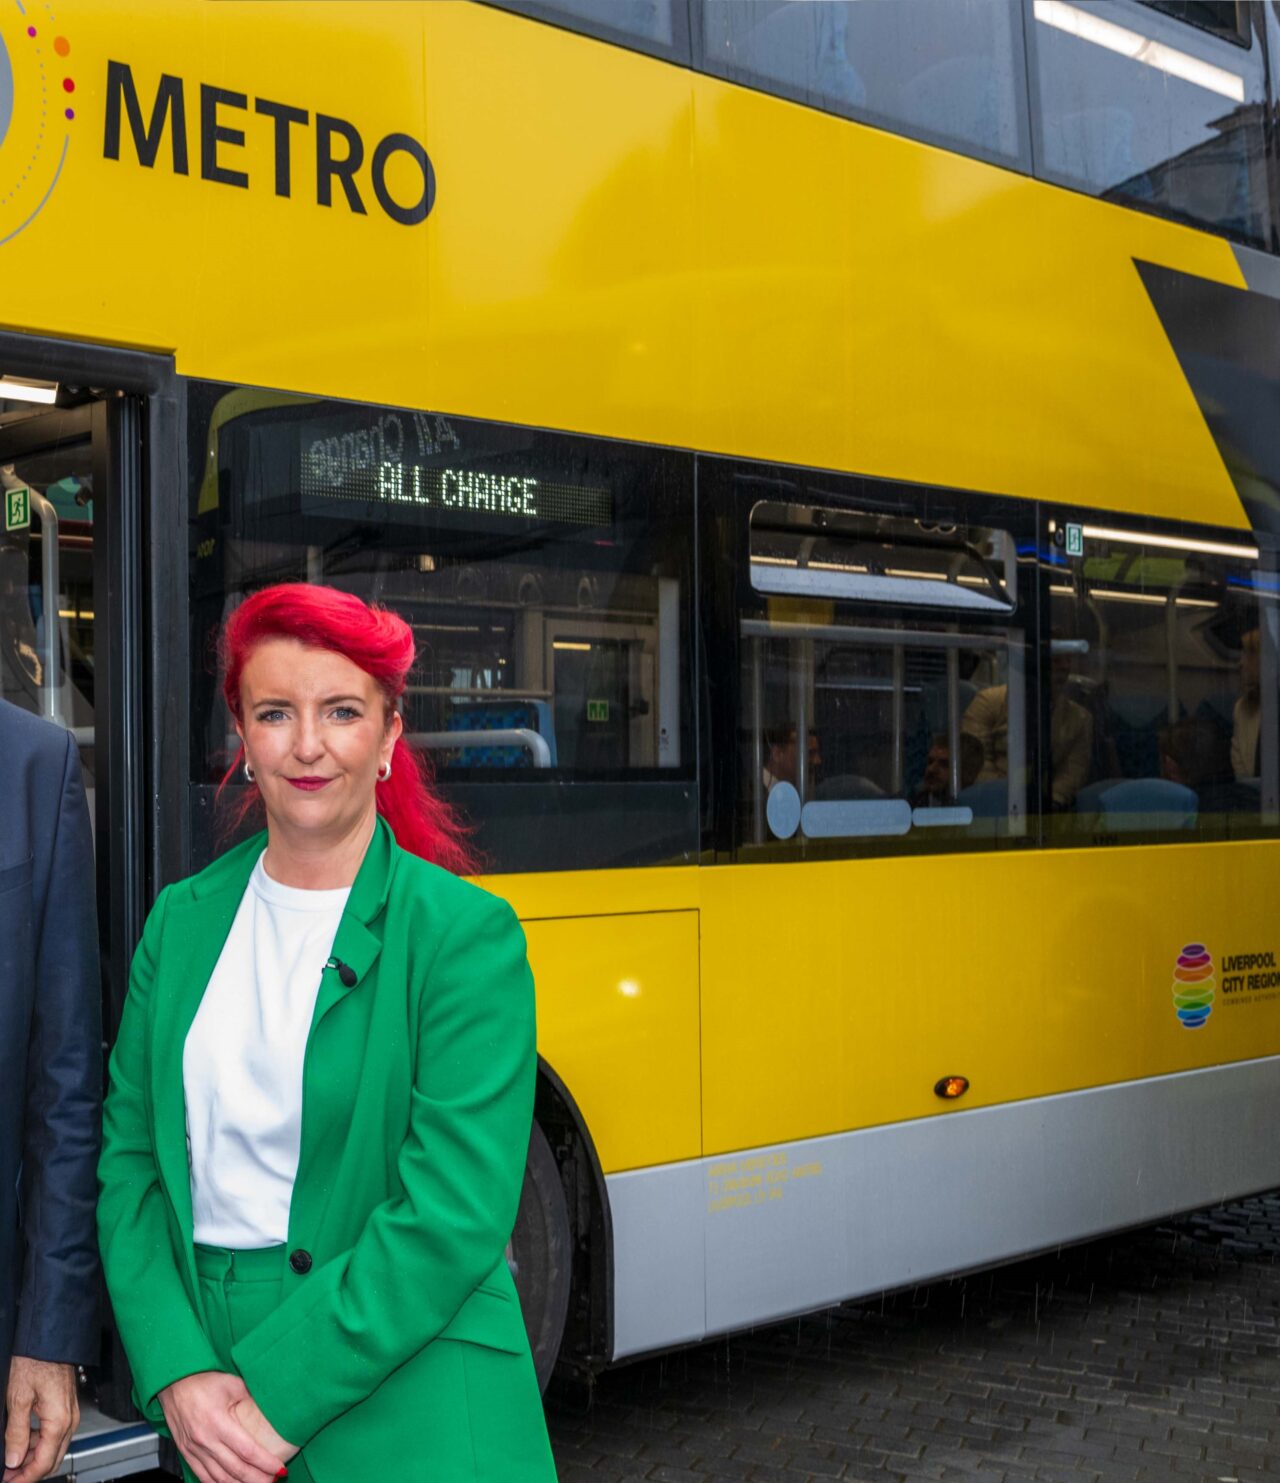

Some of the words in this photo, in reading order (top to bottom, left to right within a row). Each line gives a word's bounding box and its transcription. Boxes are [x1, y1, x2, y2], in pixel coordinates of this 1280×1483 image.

[103, 59, 436, 226] METRO
[379, 461, 429, 504] ALL
[442, 469, 537, 515] CHANGE
[1222, 952, 1277, 973] LIVERPOOL
[1222, 976, 1245, 993] CITY
